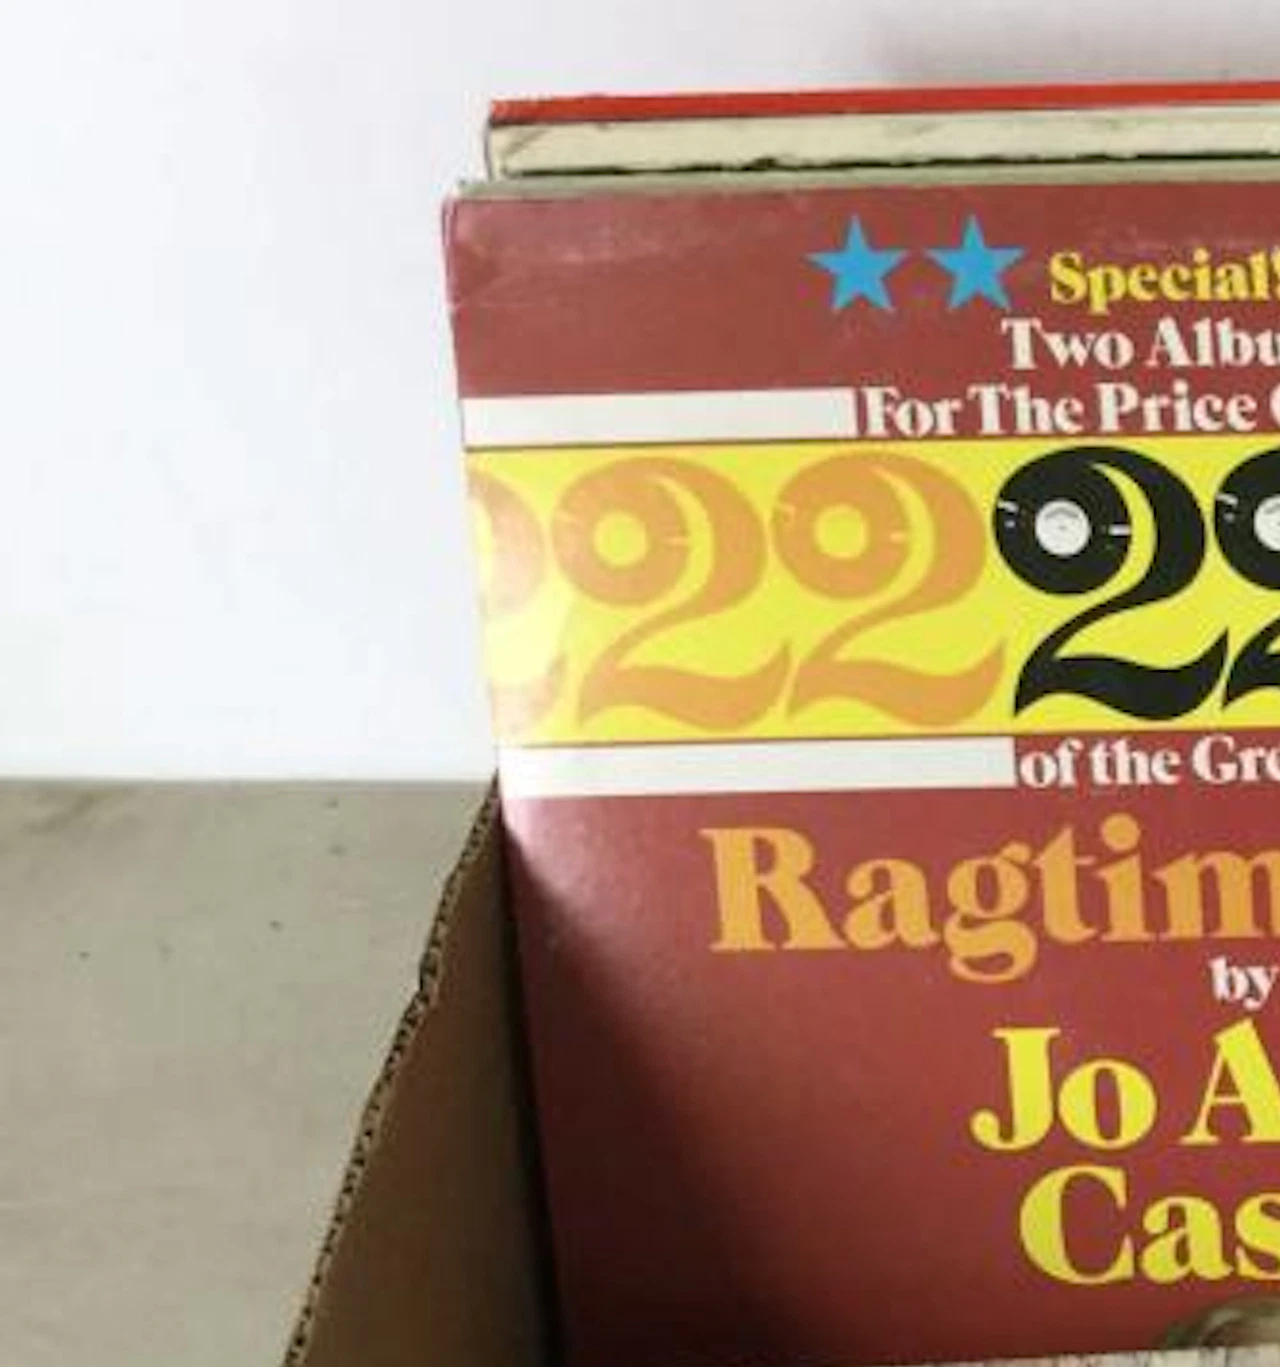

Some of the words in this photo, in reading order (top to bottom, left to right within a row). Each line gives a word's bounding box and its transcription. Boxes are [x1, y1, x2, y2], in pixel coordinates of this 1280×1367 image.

[1001, 318, 1134, 371] Two
[863, 387, 956, 438] For
[964, 384, 1089, 436] The
[1098, 381, 1257, 433] Price
[1017, 739, 1078, 787] of
[1089, 736, 1178, 785] the
[1210, 955, 1279, 1010] by
[971, 1027, 1156, 1152] Jo
